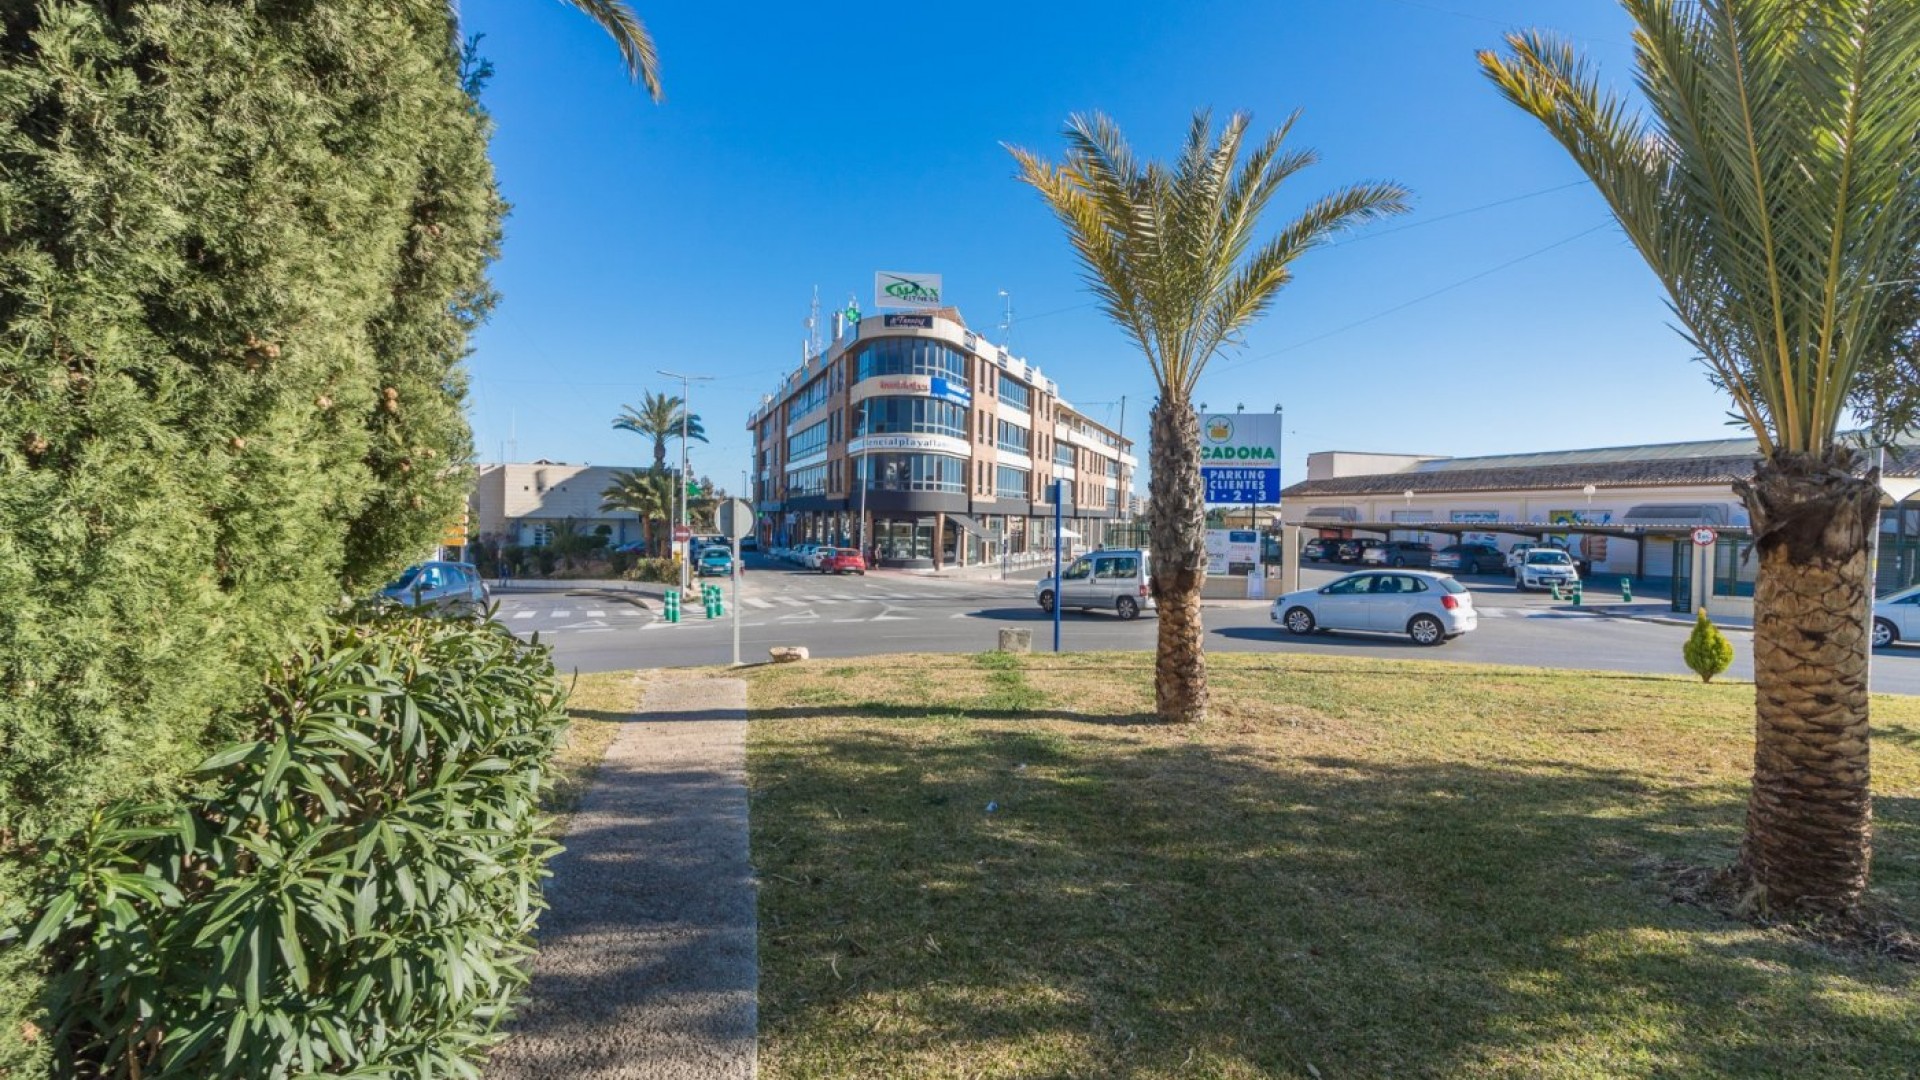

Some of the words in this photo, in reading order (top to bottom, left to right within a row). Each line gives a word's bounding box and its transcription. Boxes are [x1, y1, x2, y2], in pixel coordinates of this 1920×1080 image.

[1201, 446, 1275, 460] CADONA
[1210, 470, 1266, 480] PARKING
[1210, 480, 1265, 490] CLIENTES
[1209, 490, 1215, 501] 1
[1233, 490, 1242, 501] 2
[1258, 490, 1267, 501] 3
